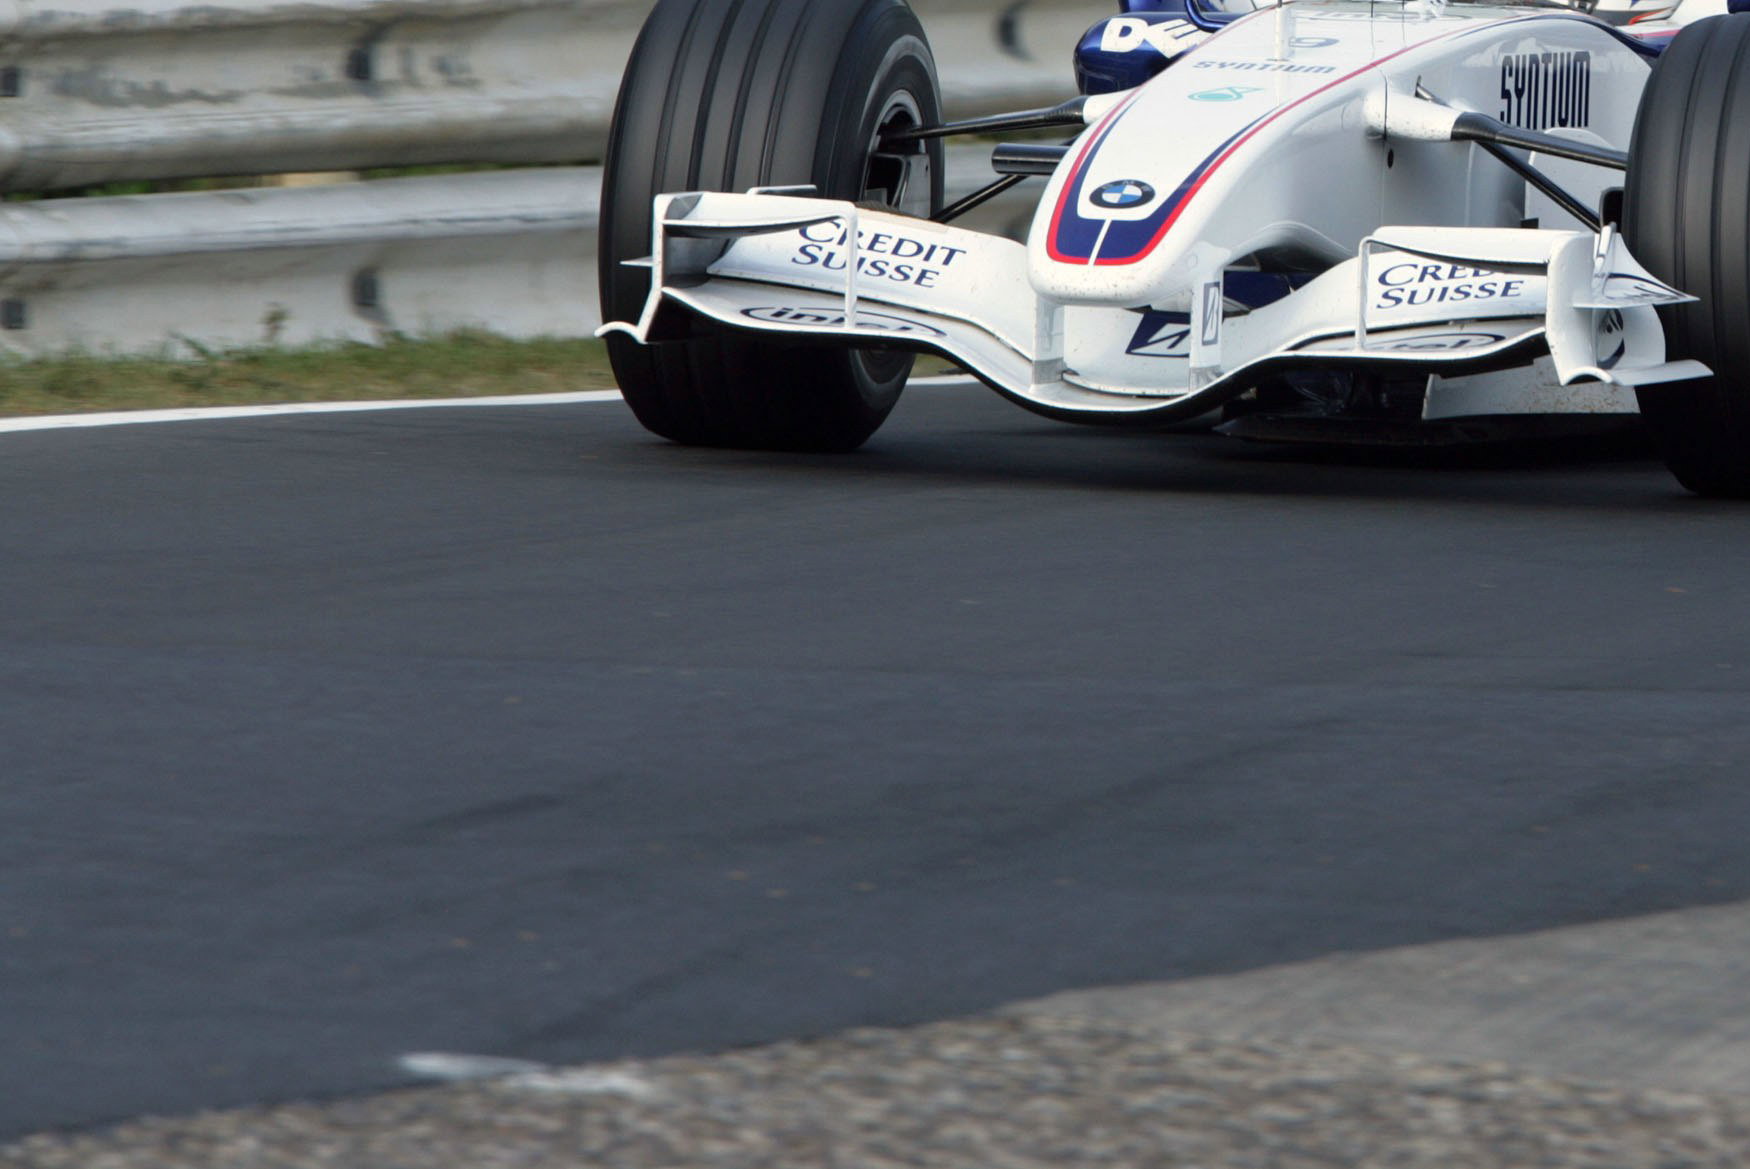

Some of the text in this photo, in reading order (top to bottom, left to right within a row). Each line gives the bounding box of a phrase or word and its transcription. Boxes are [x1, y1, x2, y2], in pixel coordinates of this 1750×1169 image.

[1500, 50, 1591, 131] SYNTIUM
[791, 243, 940, 288] SUISSE
[798, 219, 967, 267] CREDIT
[1376, 280, 1524, 309] SUISSE
